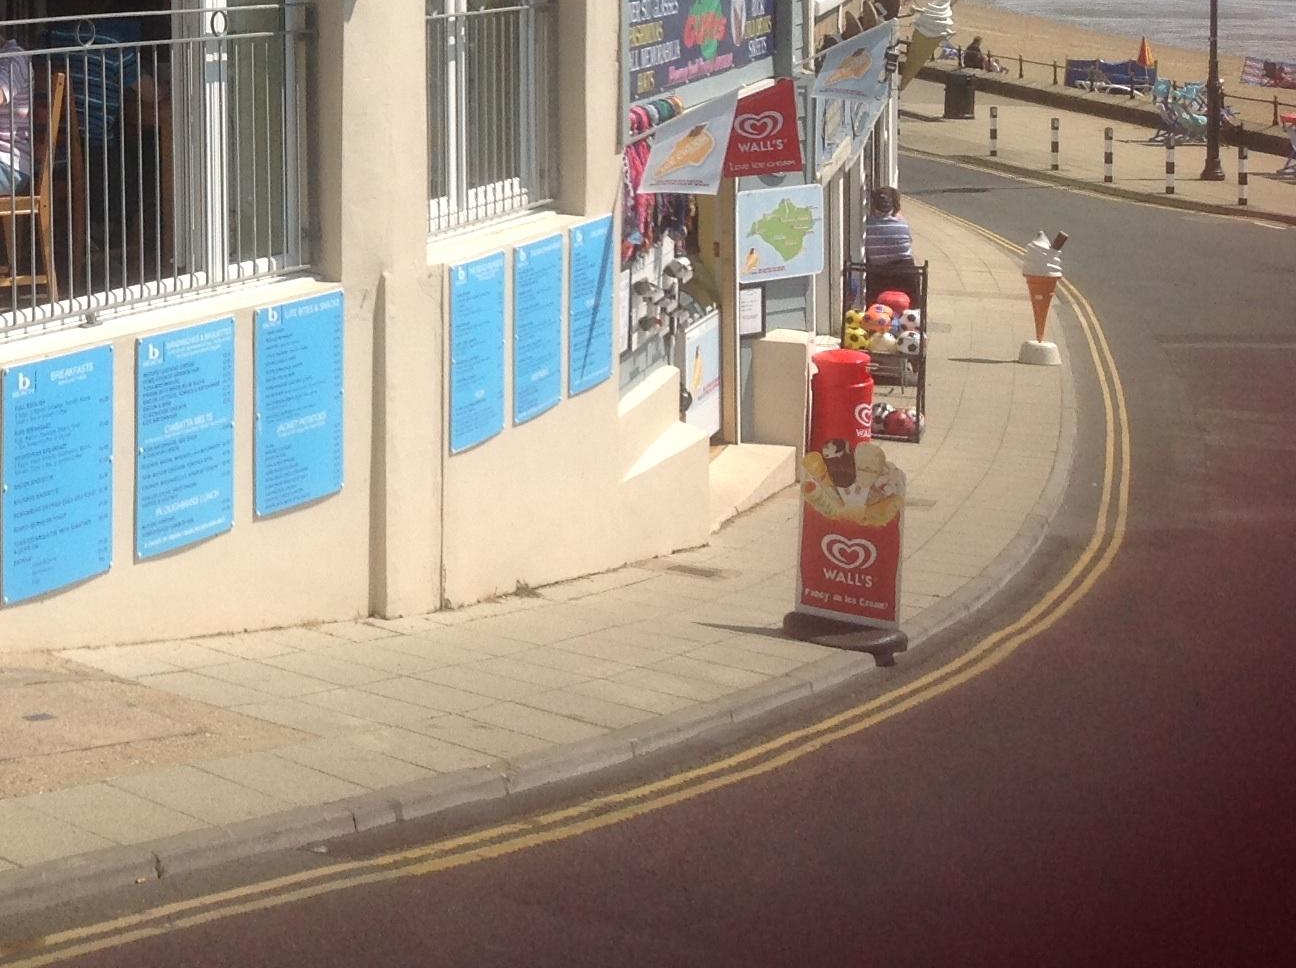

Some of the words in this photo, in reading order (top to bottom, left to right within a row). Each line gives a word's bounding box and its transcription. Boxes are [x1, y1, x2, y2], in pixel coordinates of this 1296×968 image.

[738, 138, 784, 153] WALL'S
[18, 372, 31, 391] b
[823, 567, 874, 588] WALL'S
